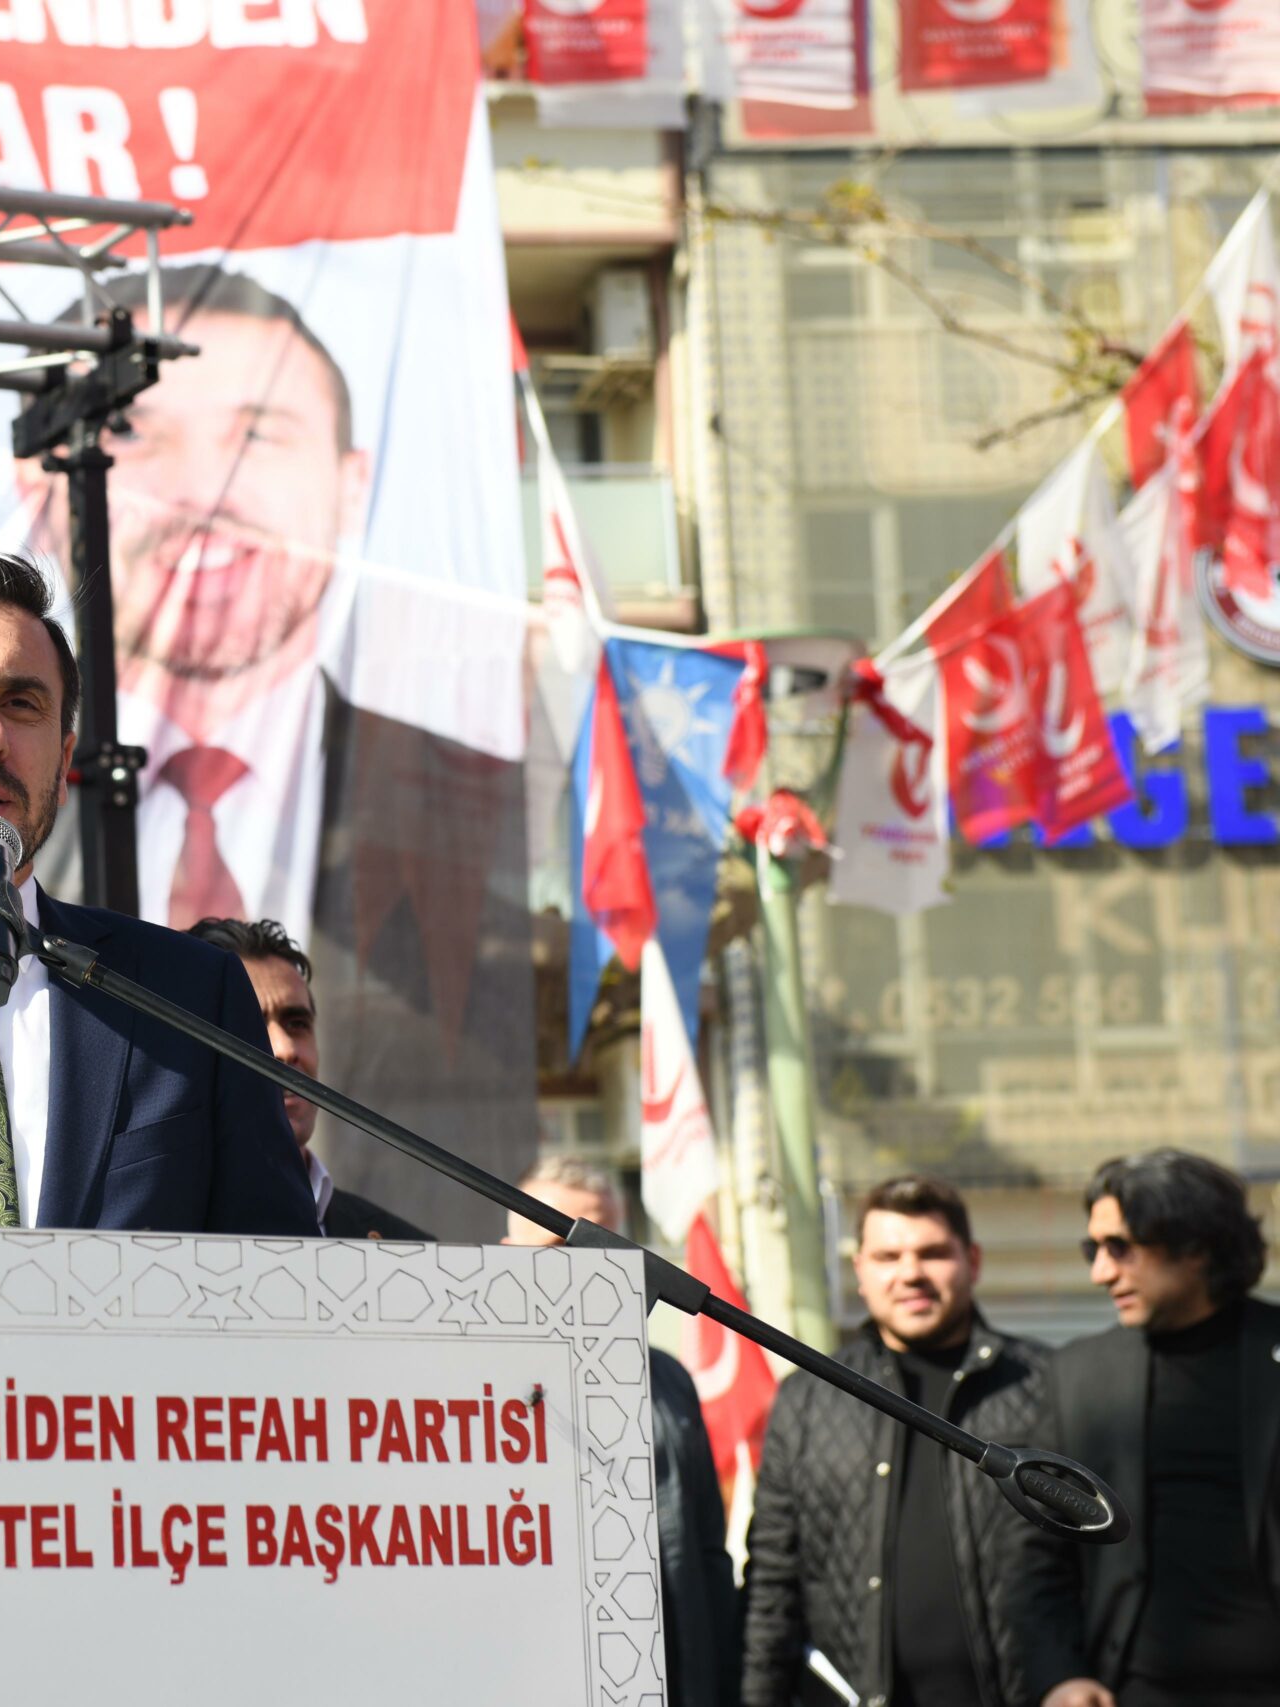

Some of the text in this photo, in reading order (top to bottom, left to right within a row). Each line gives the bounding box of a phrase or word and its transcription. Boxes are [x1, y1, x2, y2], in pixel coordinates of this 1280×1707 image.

[156, 1396, 329, 1462] REFAH
[348, 1382, 548, 1464] PARTİSİ
[112, 1488, 228, 1585] İLÇE
[245, 1488, 553, 1584] BAŞKANLIĞI
